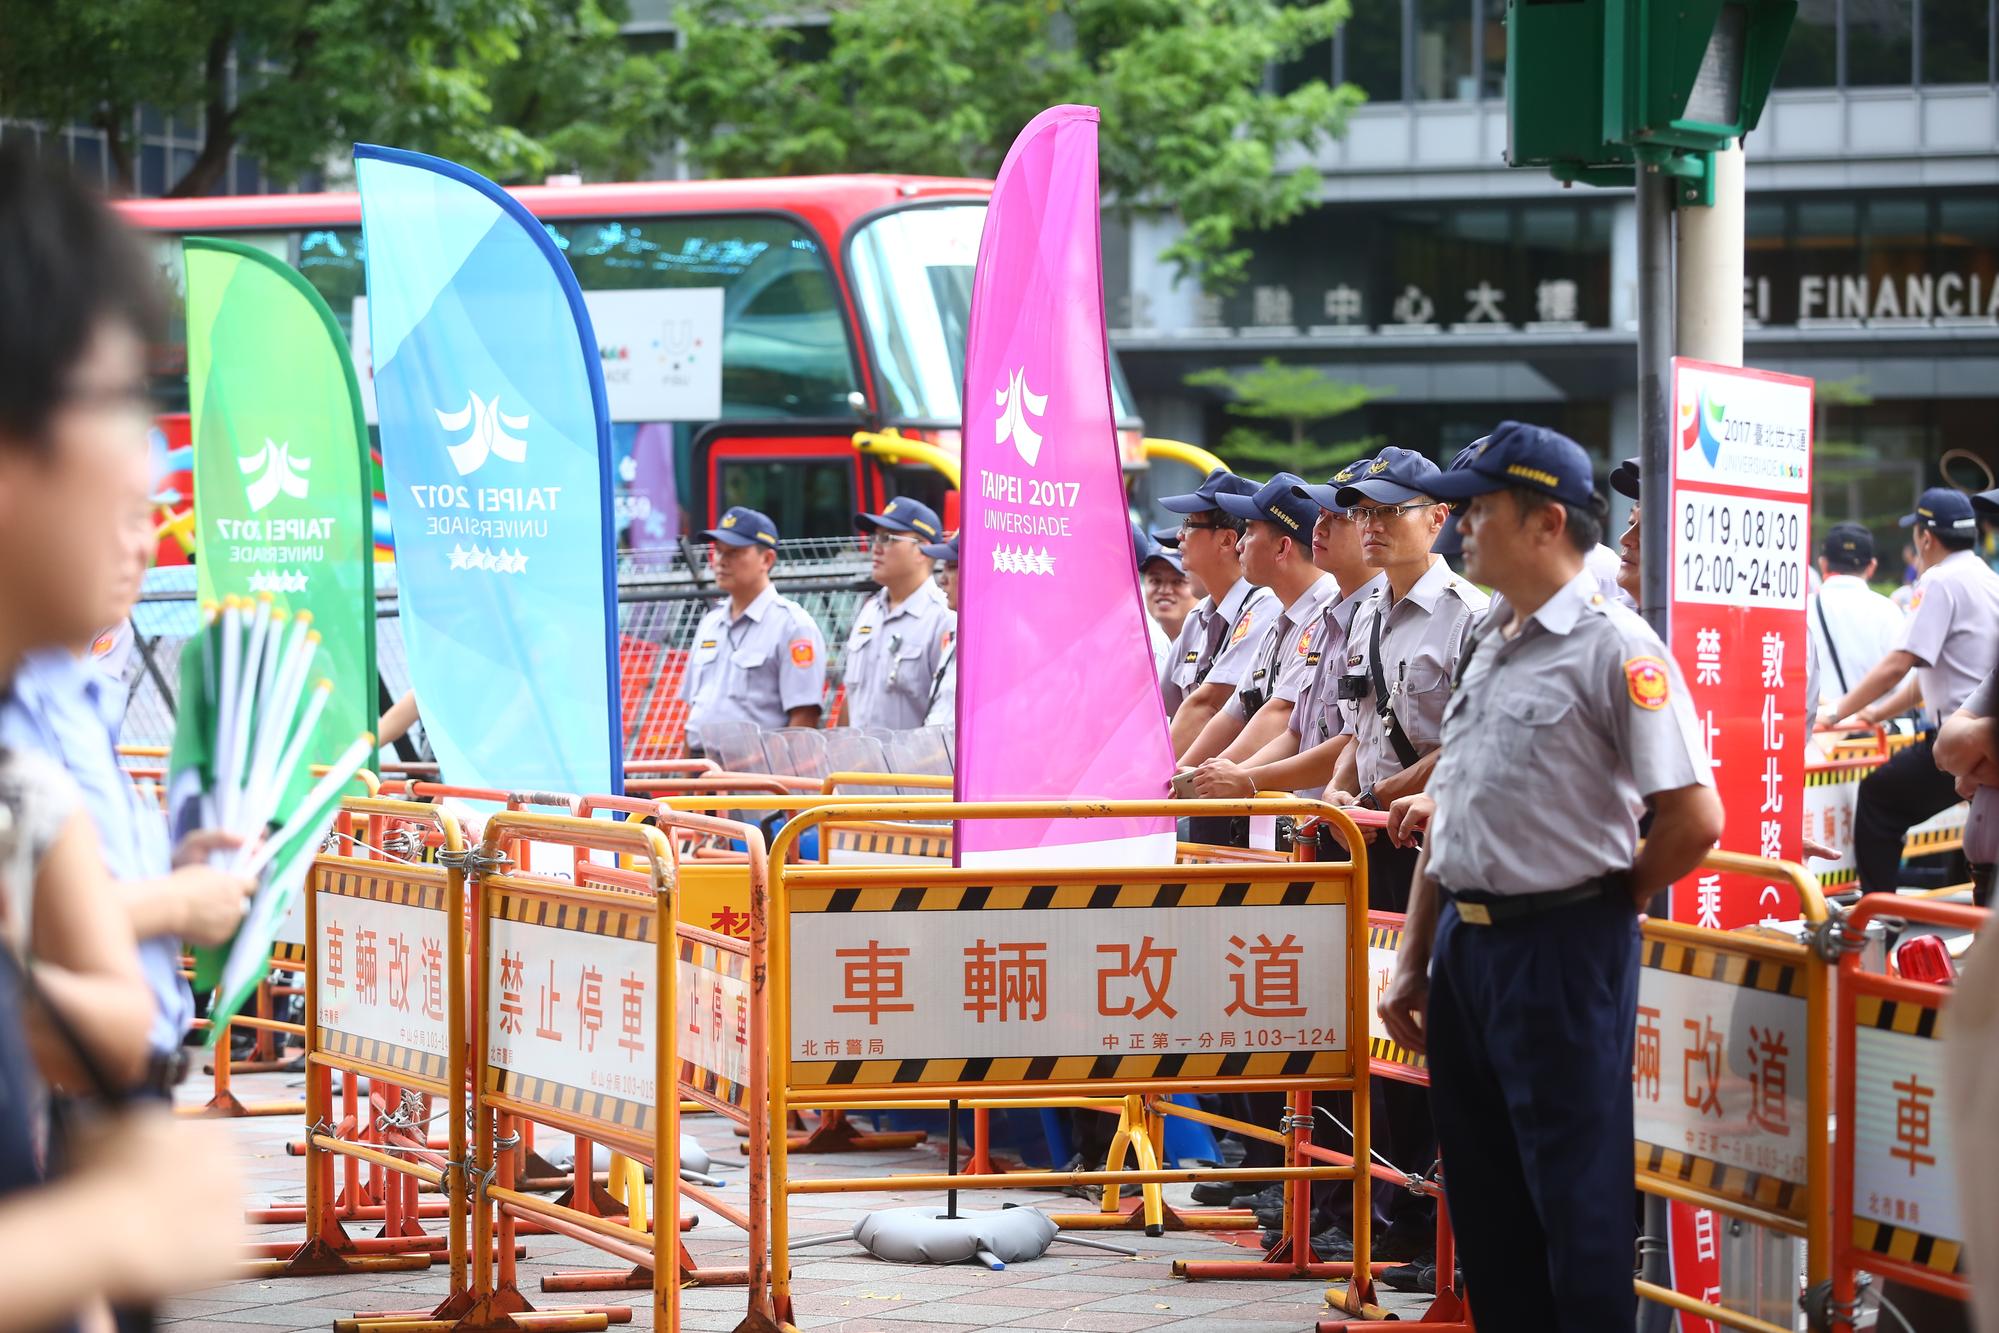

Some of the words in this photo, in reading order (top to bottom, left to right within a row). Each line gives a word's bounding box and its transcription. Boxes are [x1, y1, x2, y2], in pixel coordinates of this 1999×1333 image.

[1723, 418, 1751, 443] 2017
[981, 469, 1022, 504] TAIPEI
[1029, 479, 1081, 508] 2017
[984, 508, 1073, 537] UNIVERSIADE
[326, 920, 445, 1022] 車輛改道
[499, 949, 645, 1063] 禁止停車
[832, 933, 1310, 1025] 車輛改道
[689, 972, 748, 1054] 止停車
[801, 1037, 885, 1057] 北市警局
[1889, 1073, 1936, 1177] 車
